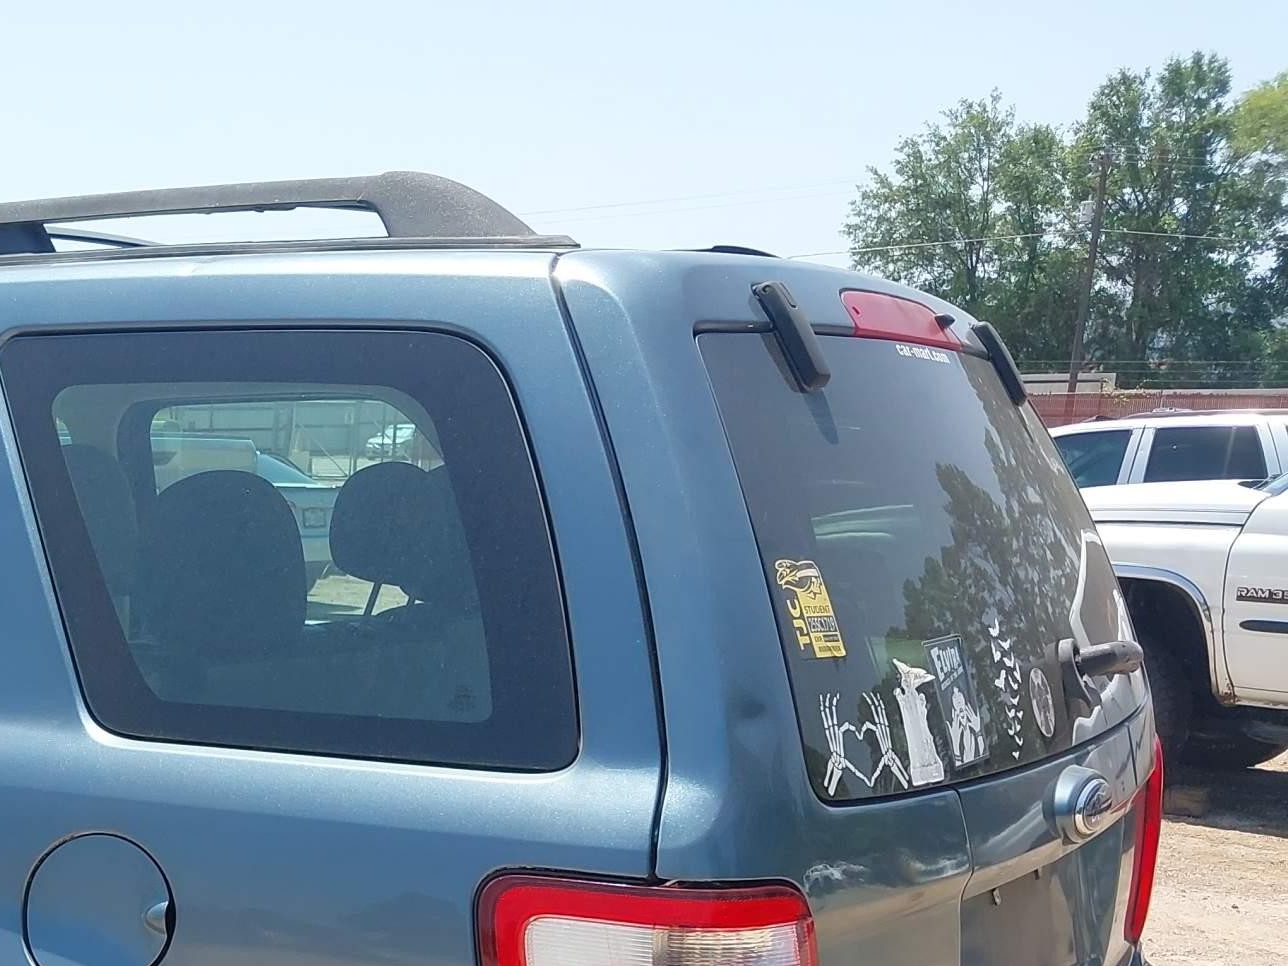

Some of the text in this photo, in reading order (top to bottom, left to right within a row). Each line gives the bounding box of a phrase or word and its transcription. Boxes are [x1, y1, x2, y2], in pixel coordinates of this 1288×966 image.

[895, 344, 951, 364] car-mart.com
[1237, 588, 1270, 599] RAM
[803, 605, 832, 615] STUDENT
[785, 599, 811, 651] TJC
